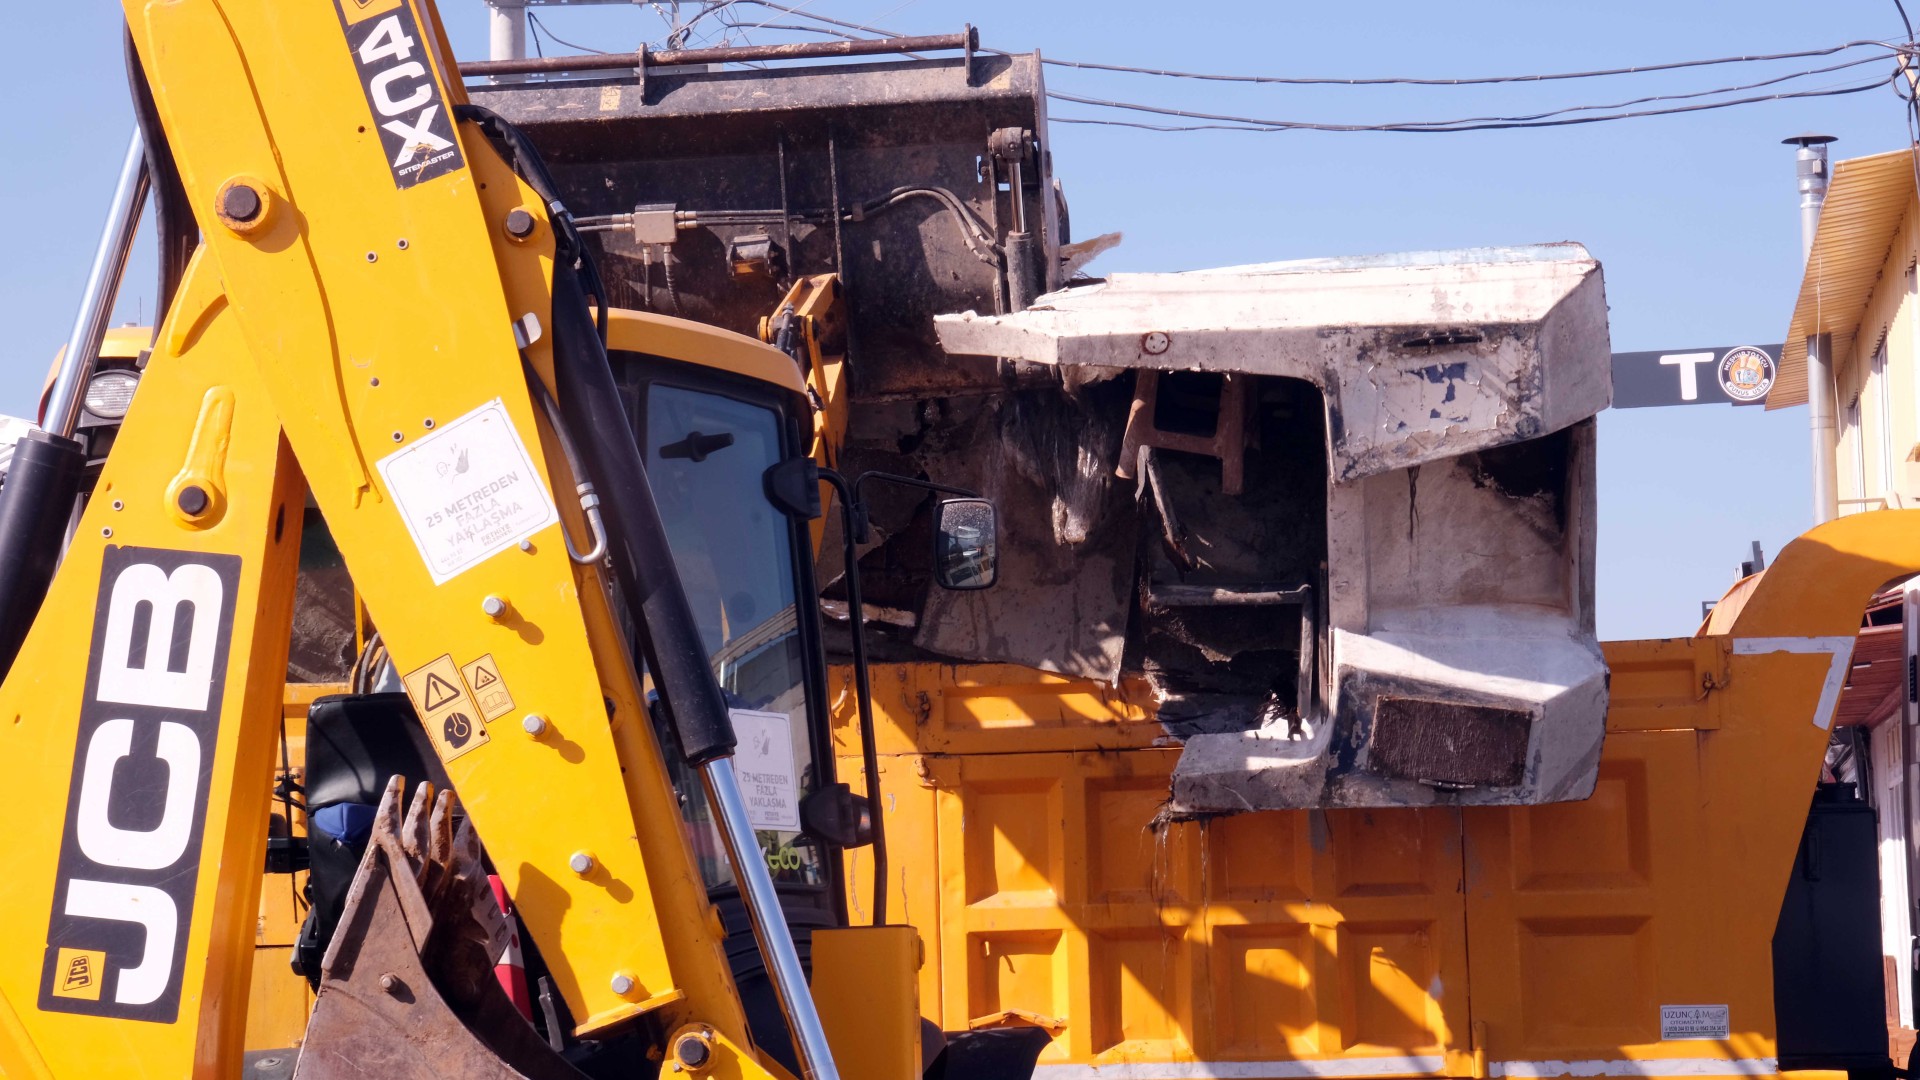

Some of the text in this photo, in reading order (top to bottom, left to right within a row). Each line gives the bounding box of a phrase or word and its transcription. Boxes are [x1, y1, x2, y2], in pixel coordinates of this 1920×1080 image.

[359, 15, 454, 168] 4CX
[398, 151, 455, 176] SITEMASTER
[1659, 352, 1715, 400] T
[1728, 382, 1768, 396] YUNUS USTA
[425, 512, 443, 529] 25
[444, 471, 520, 518] METREDEN
[455, 497, 501, 528] FAZLA
[446, 501, 523, 547] YAKLAŞMA
[65, 563, 223, 1005] JCB
[742, 771, 788, 785] 25 METREDEN
[756, 784, 778, 796] FAZLA
[749, 796, 786, 811] YAKLAŞMA
[67, 958, 89, 985] JCB
